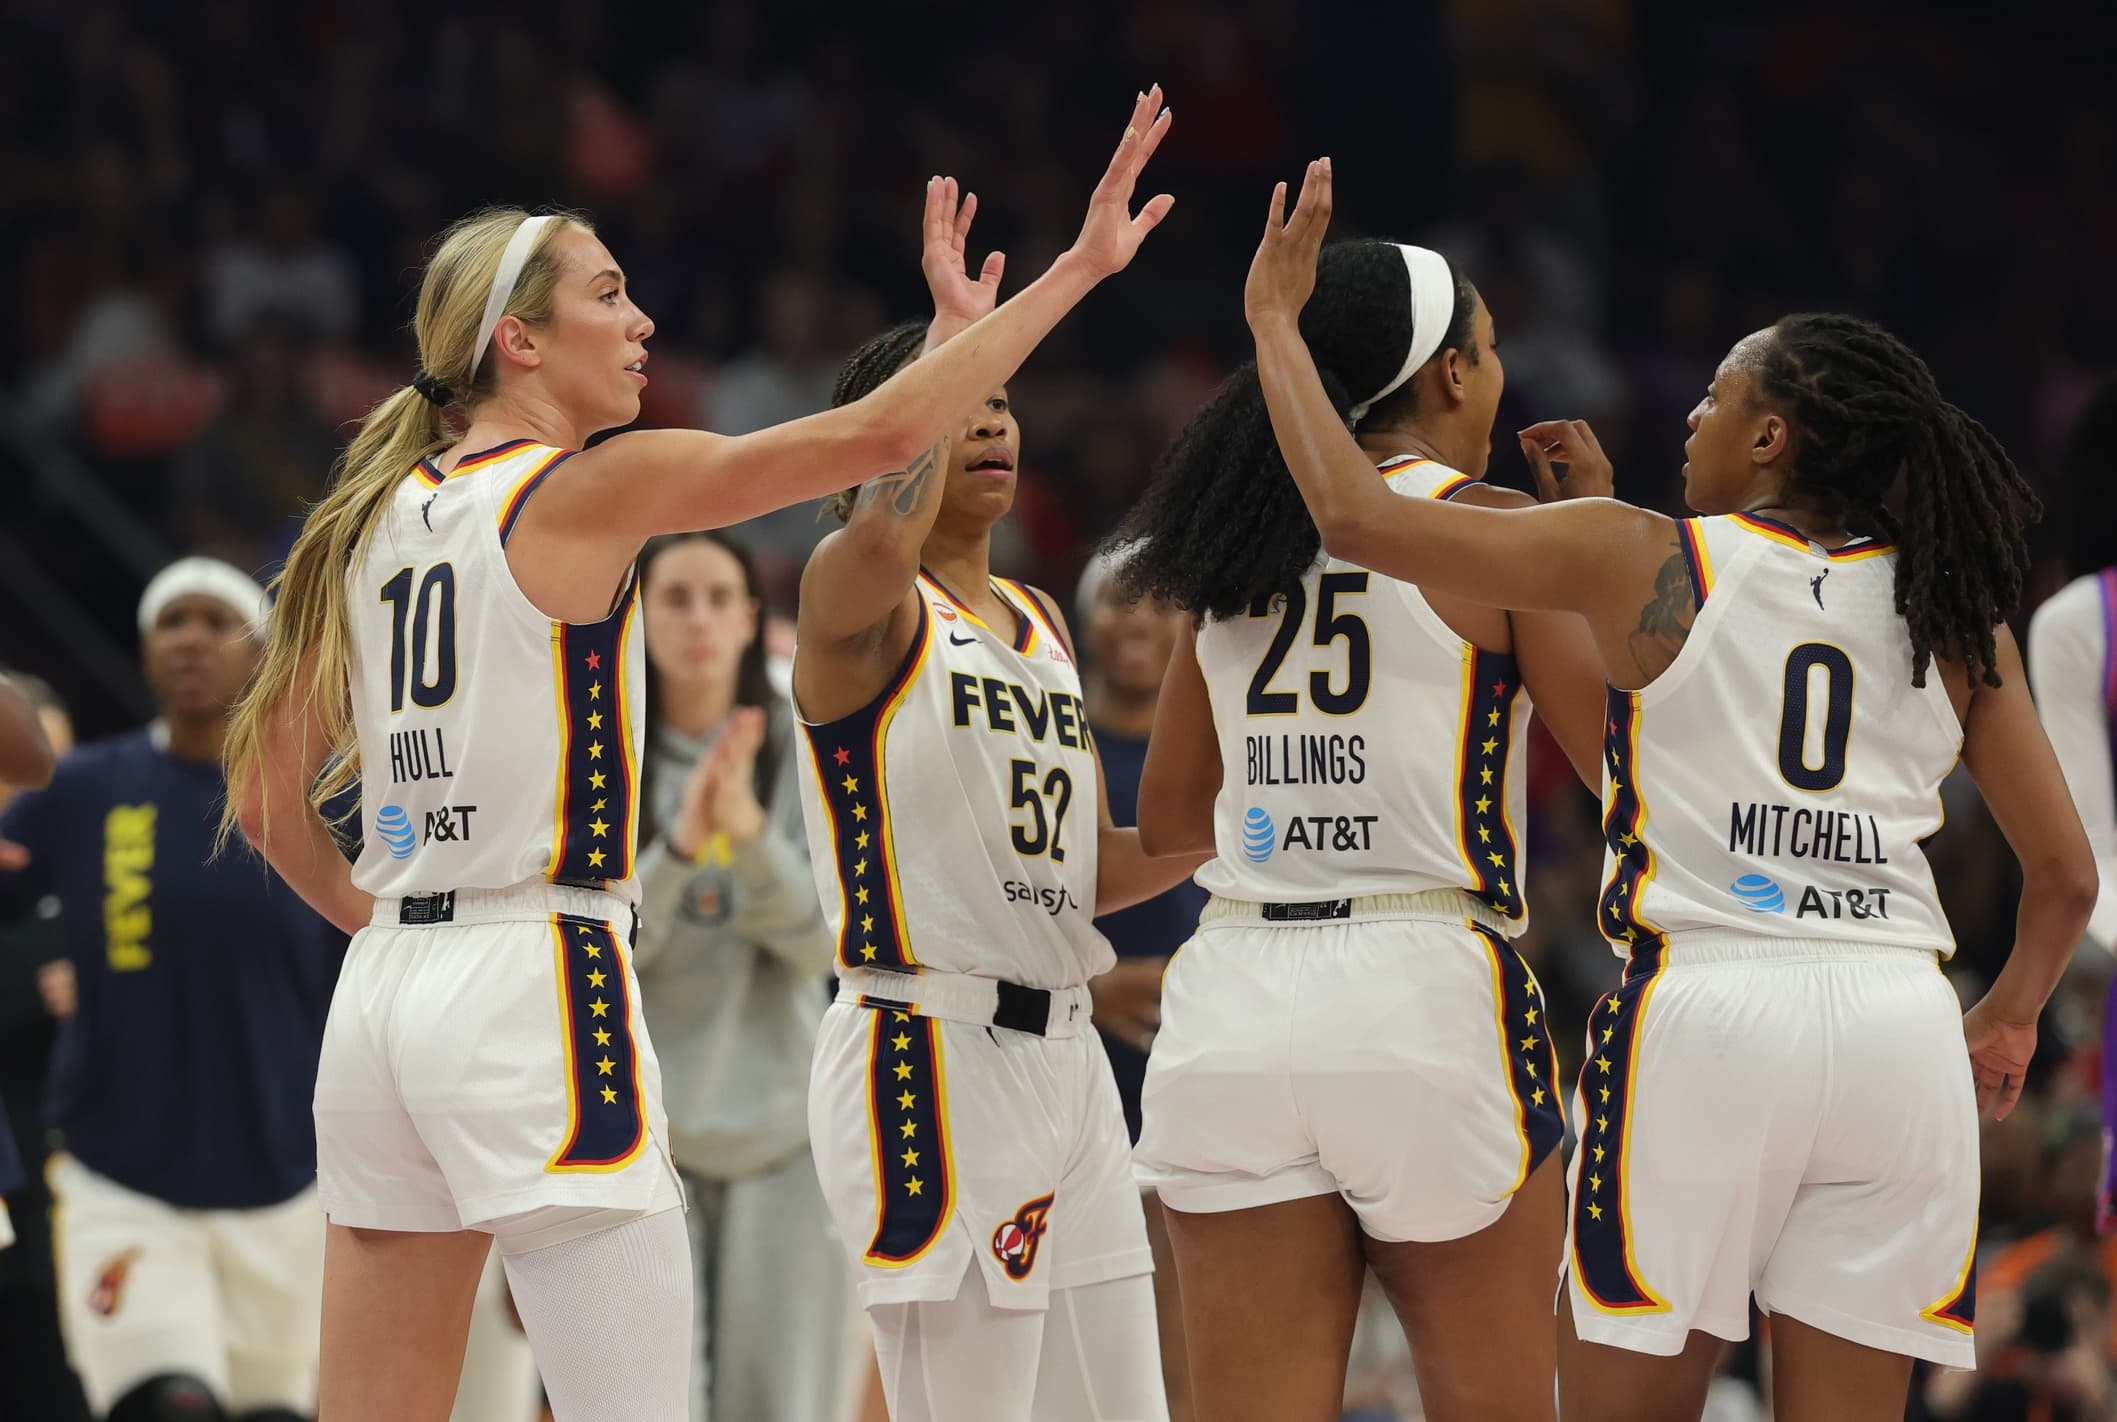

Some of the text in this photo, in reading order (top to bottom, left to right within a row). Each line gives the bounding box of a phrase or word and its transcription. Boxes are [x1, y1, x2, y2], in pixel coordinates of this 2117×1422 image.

[380, 561, 458, 715] 10
[1245, 571, 1373, 717] 25
[1776, 640, 1857, 794] 0
[390, 727, 454, 784] HULL
[1246, 734, 1366, 787] BILLINGS
[1008, 757, 1073, 864] 52
[1282, 814, 1379, 852] AT&T
[1728, 801, 1889, 865] MITCHELL
[1795, 884, 1892, 920] AT&T
